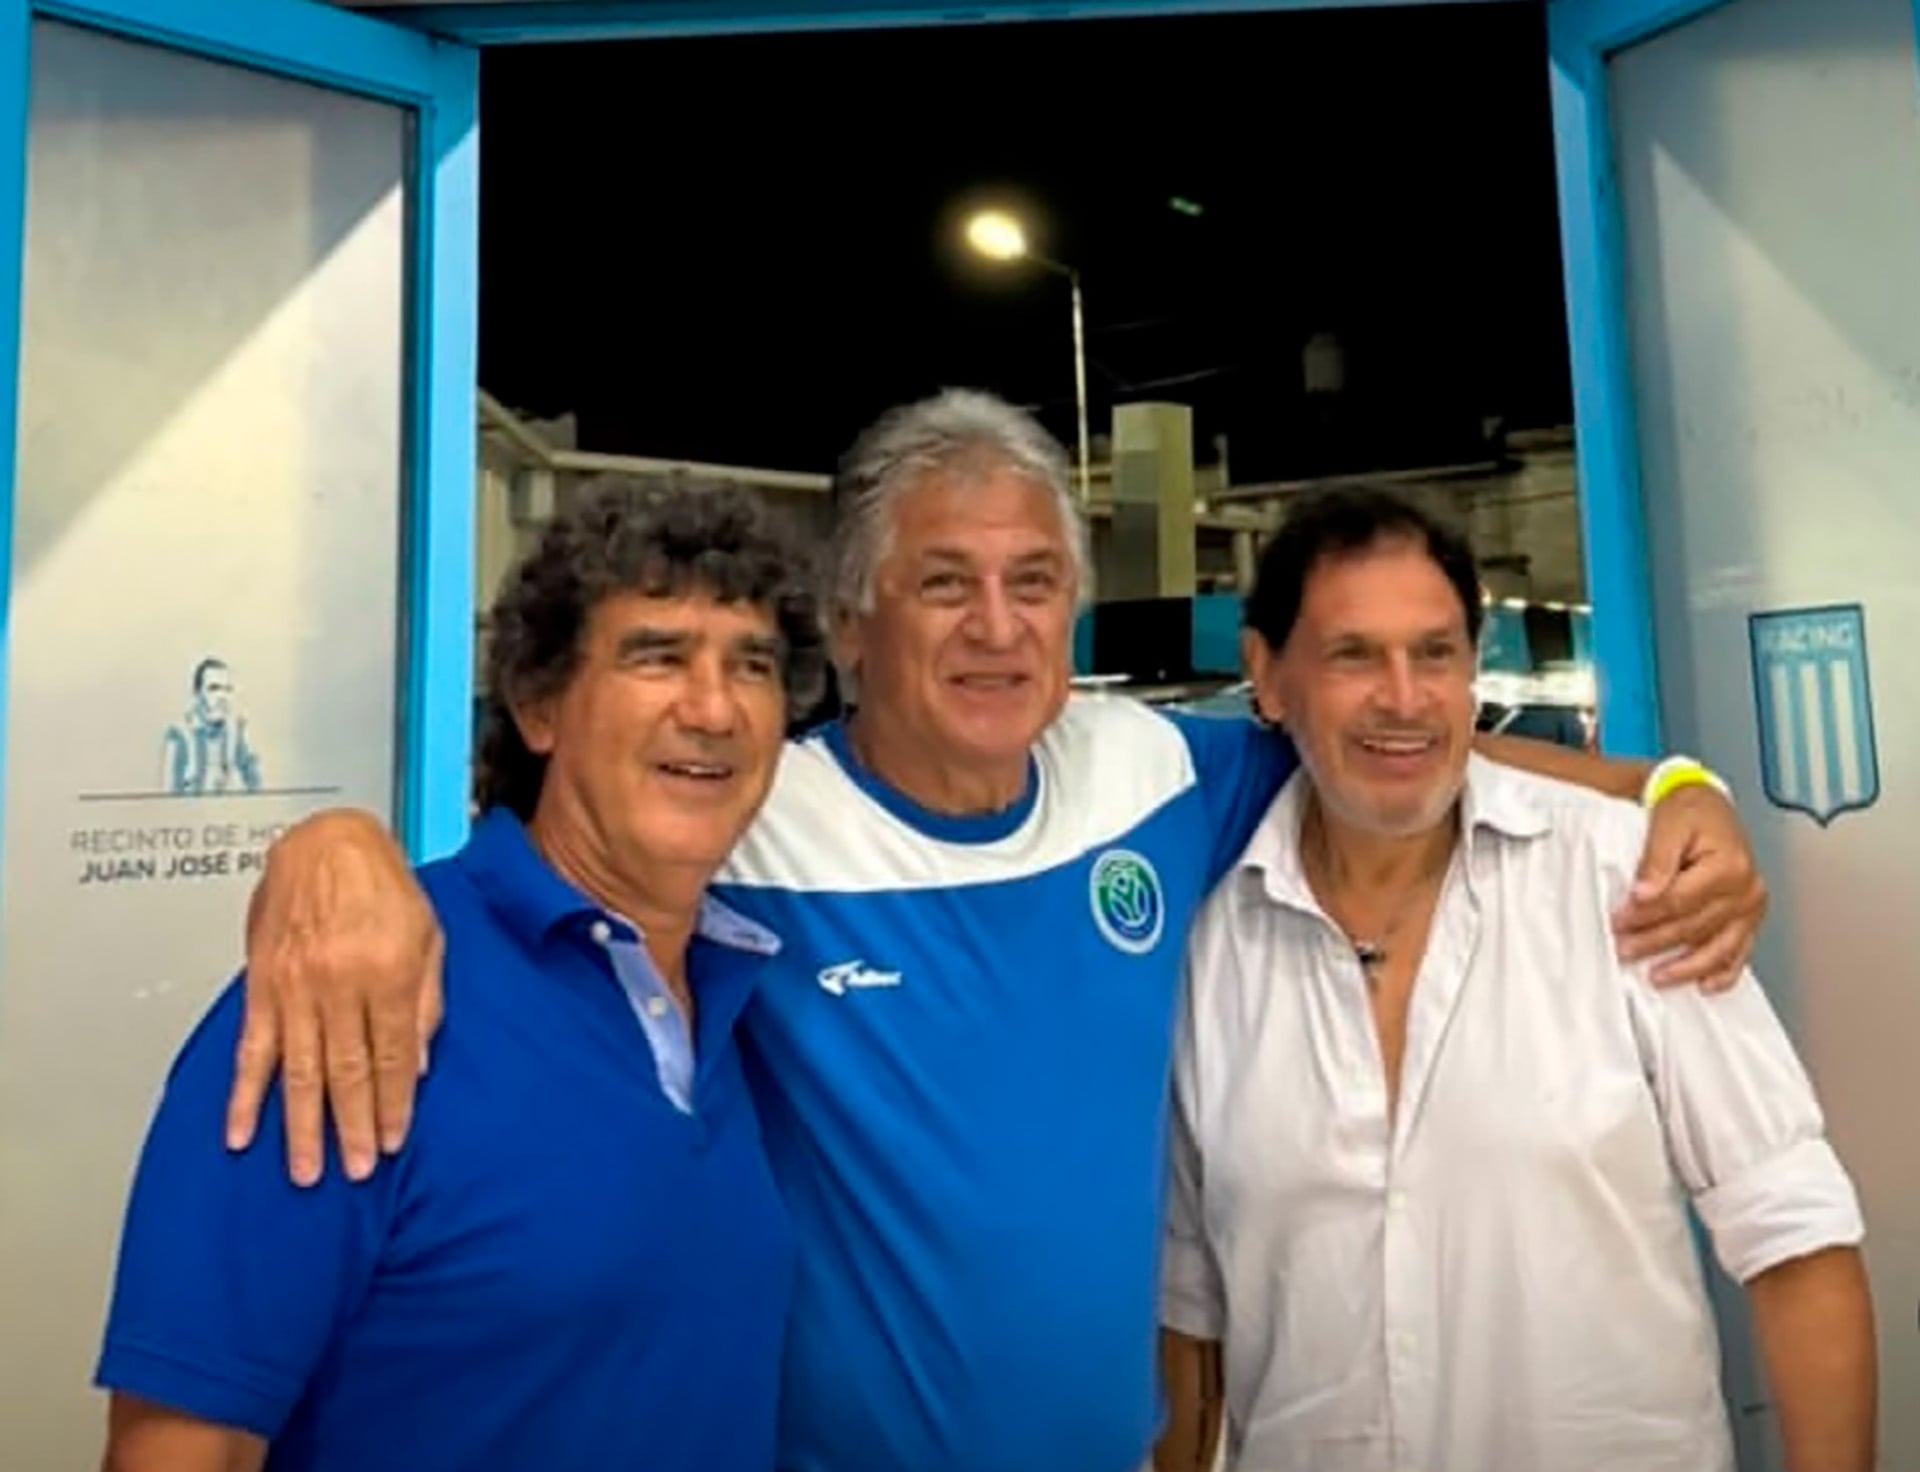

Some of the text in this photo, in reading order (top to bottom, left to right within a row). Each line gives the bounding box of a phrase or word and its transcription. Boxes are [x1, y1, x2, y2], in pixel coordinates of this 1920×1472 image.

[1758, 621, 1855, 653] RACING
[70, 828, 194, 852] RECINTO
[203, 825, 240, 847] DE
[79, 858, 156, 884] JUAN
